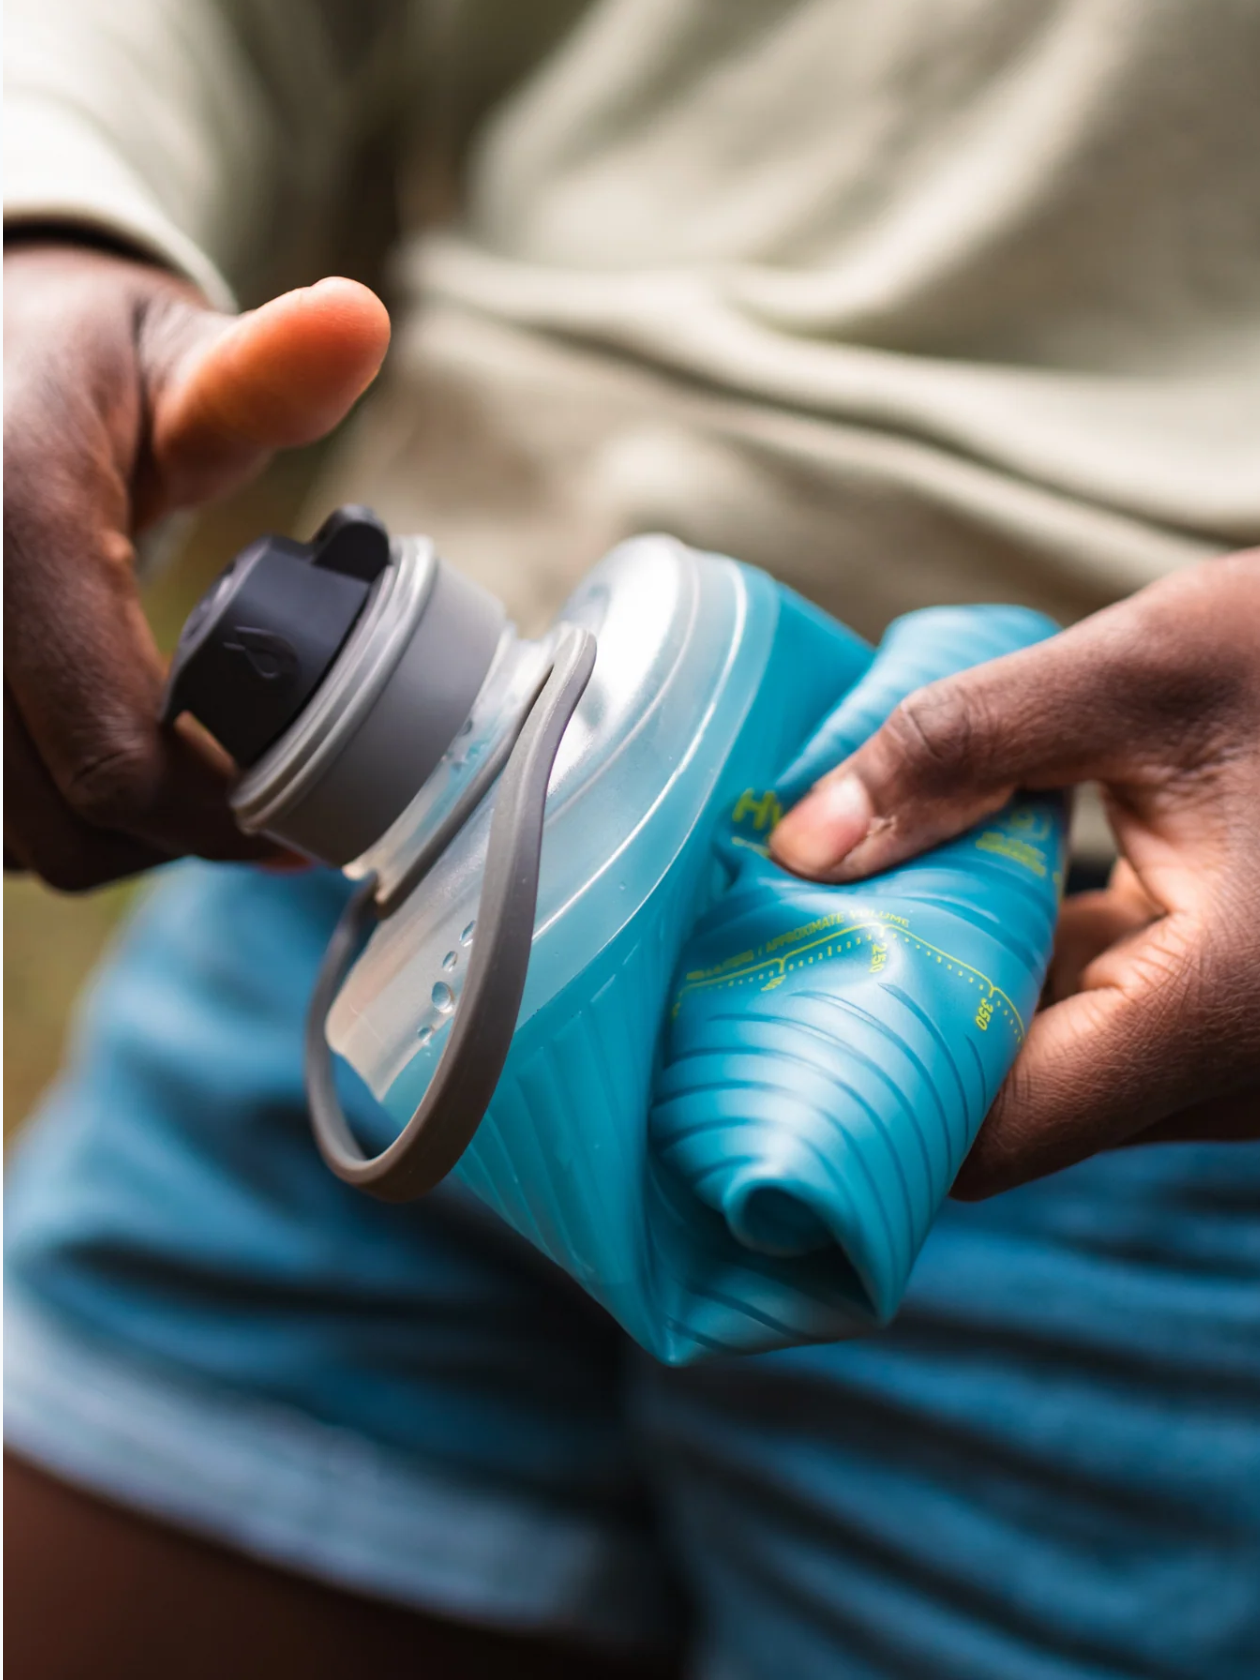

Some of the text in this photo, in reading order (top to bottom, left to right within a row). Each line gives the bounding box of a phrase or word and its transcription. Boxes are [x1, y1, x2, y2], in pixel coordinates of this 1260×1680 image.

[766, 911, 844, 953] APPROXIMATE
[869, 942, 888, 973] 250
[975, 997, 993, 1031] 350
